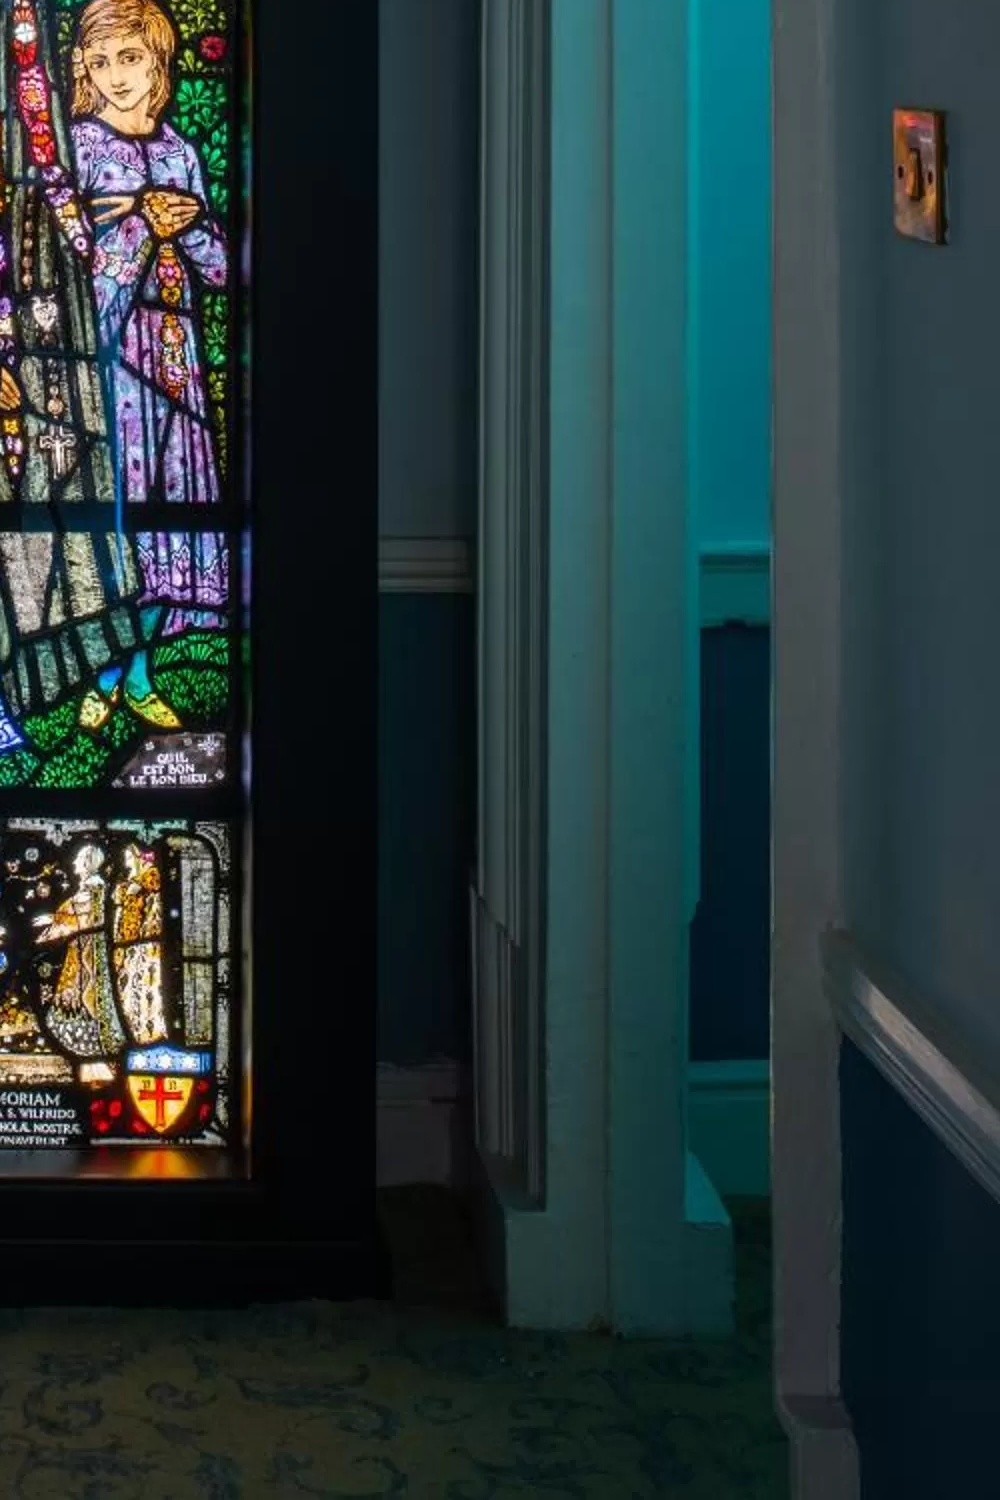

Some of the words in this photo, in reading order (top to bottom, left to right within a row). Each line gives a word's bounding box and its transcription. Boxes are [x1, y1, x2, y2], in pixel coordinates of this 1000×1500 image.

[142, 765, 165, 775] EST
[168, 764, 195, 775] BON
[129, 775, 147, 786] LE
[150, 775, 177, 786] BON
